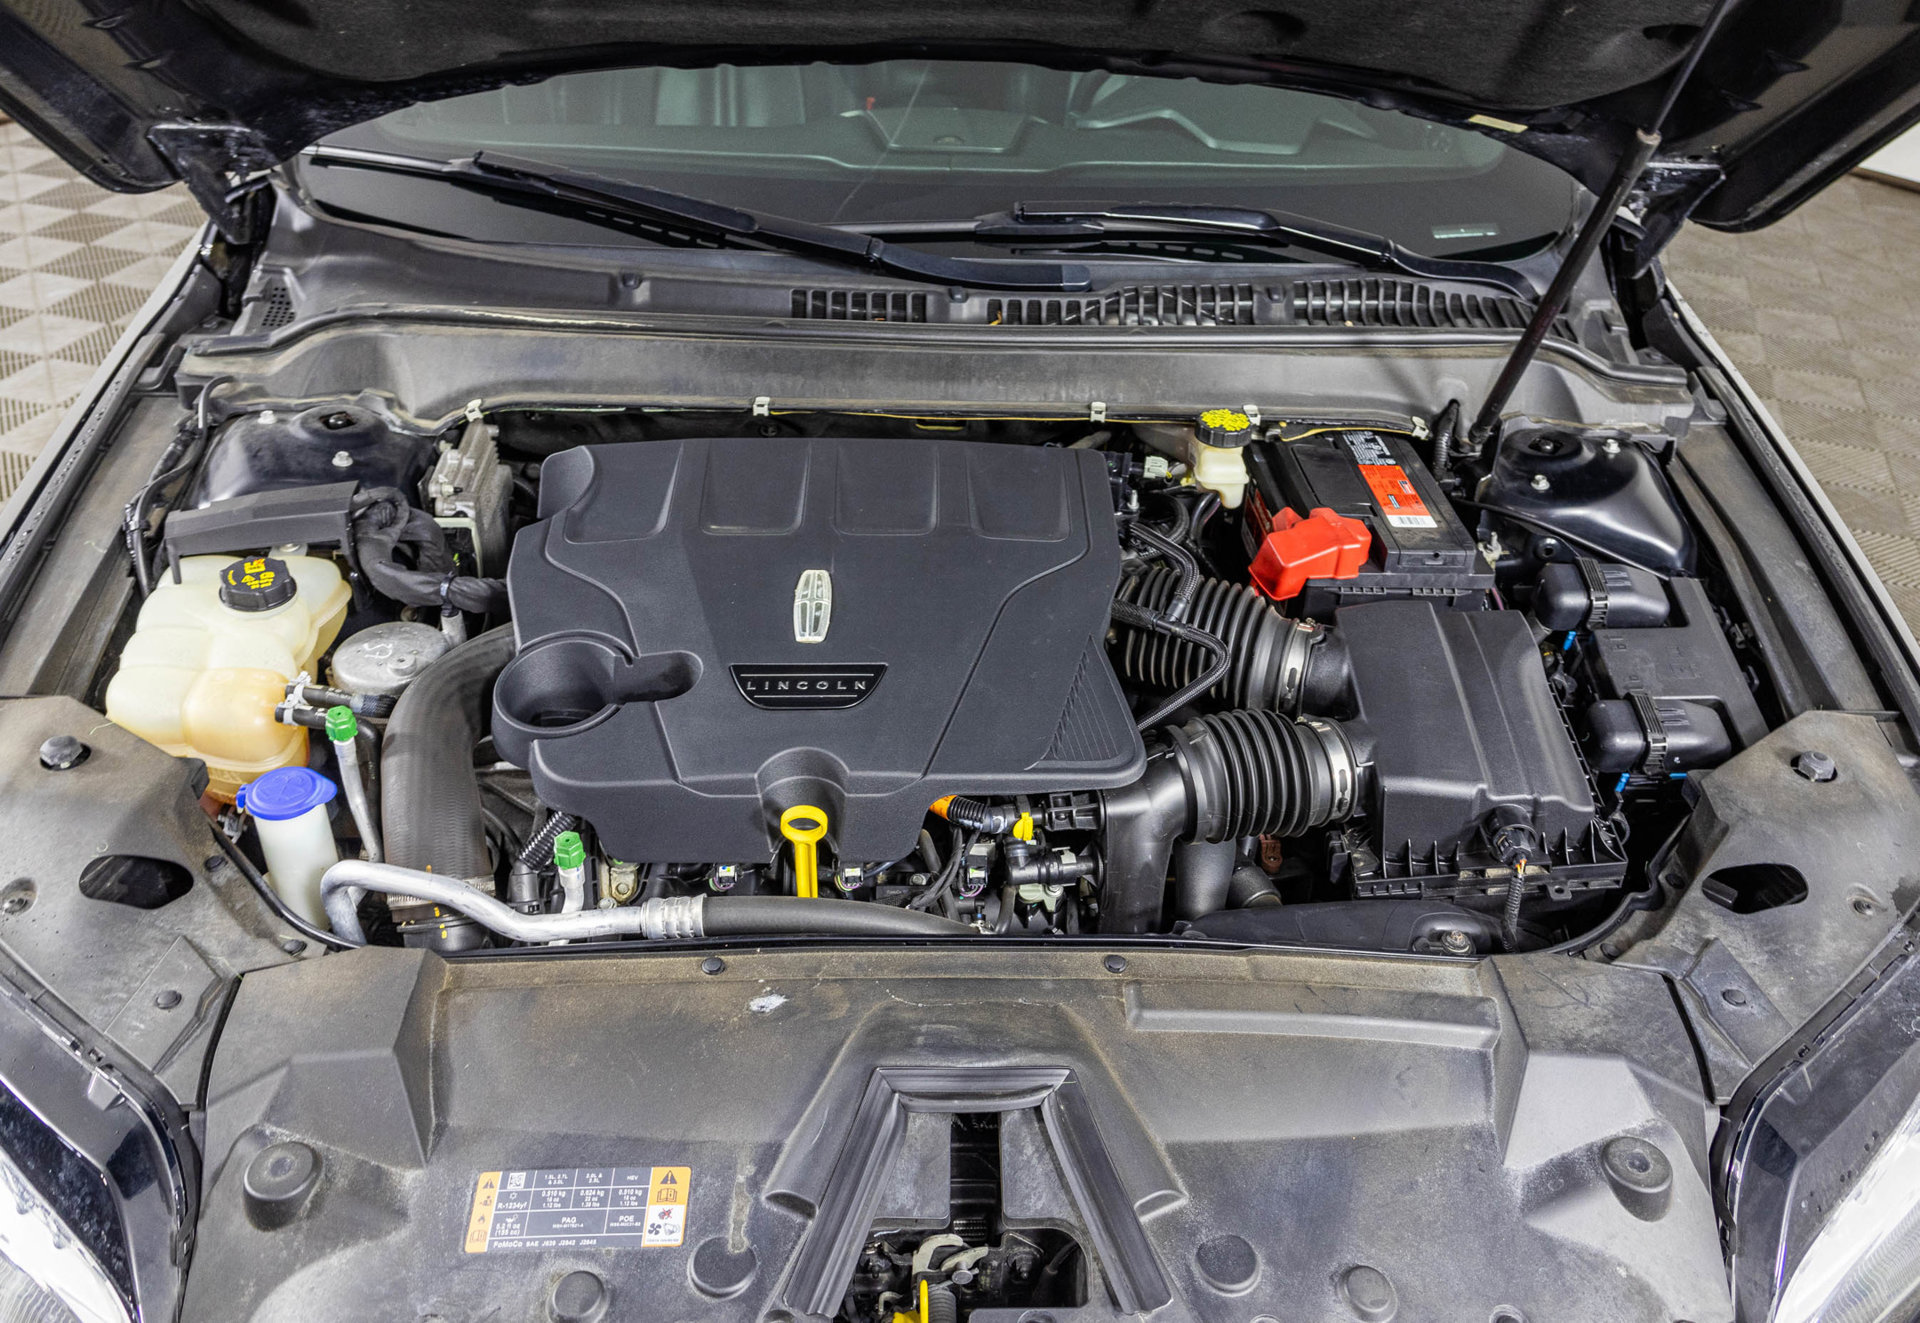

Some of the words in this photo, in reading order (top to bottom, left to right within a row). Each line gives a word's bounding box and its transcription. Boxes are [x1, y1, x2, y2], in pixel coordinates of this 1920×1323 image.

[746, 681, 866, 690] LINCOLN
[558, 1190, 566, 1198] kg
[596, 1189, 605, 1197] kg
[634, 1188, 643, 1197] kg
[497, 1201, 528, 1210] R-1234yf
[561, 1216, 577, 1224] PAG
[493, 1240, 523, 1248] FoMoCo
